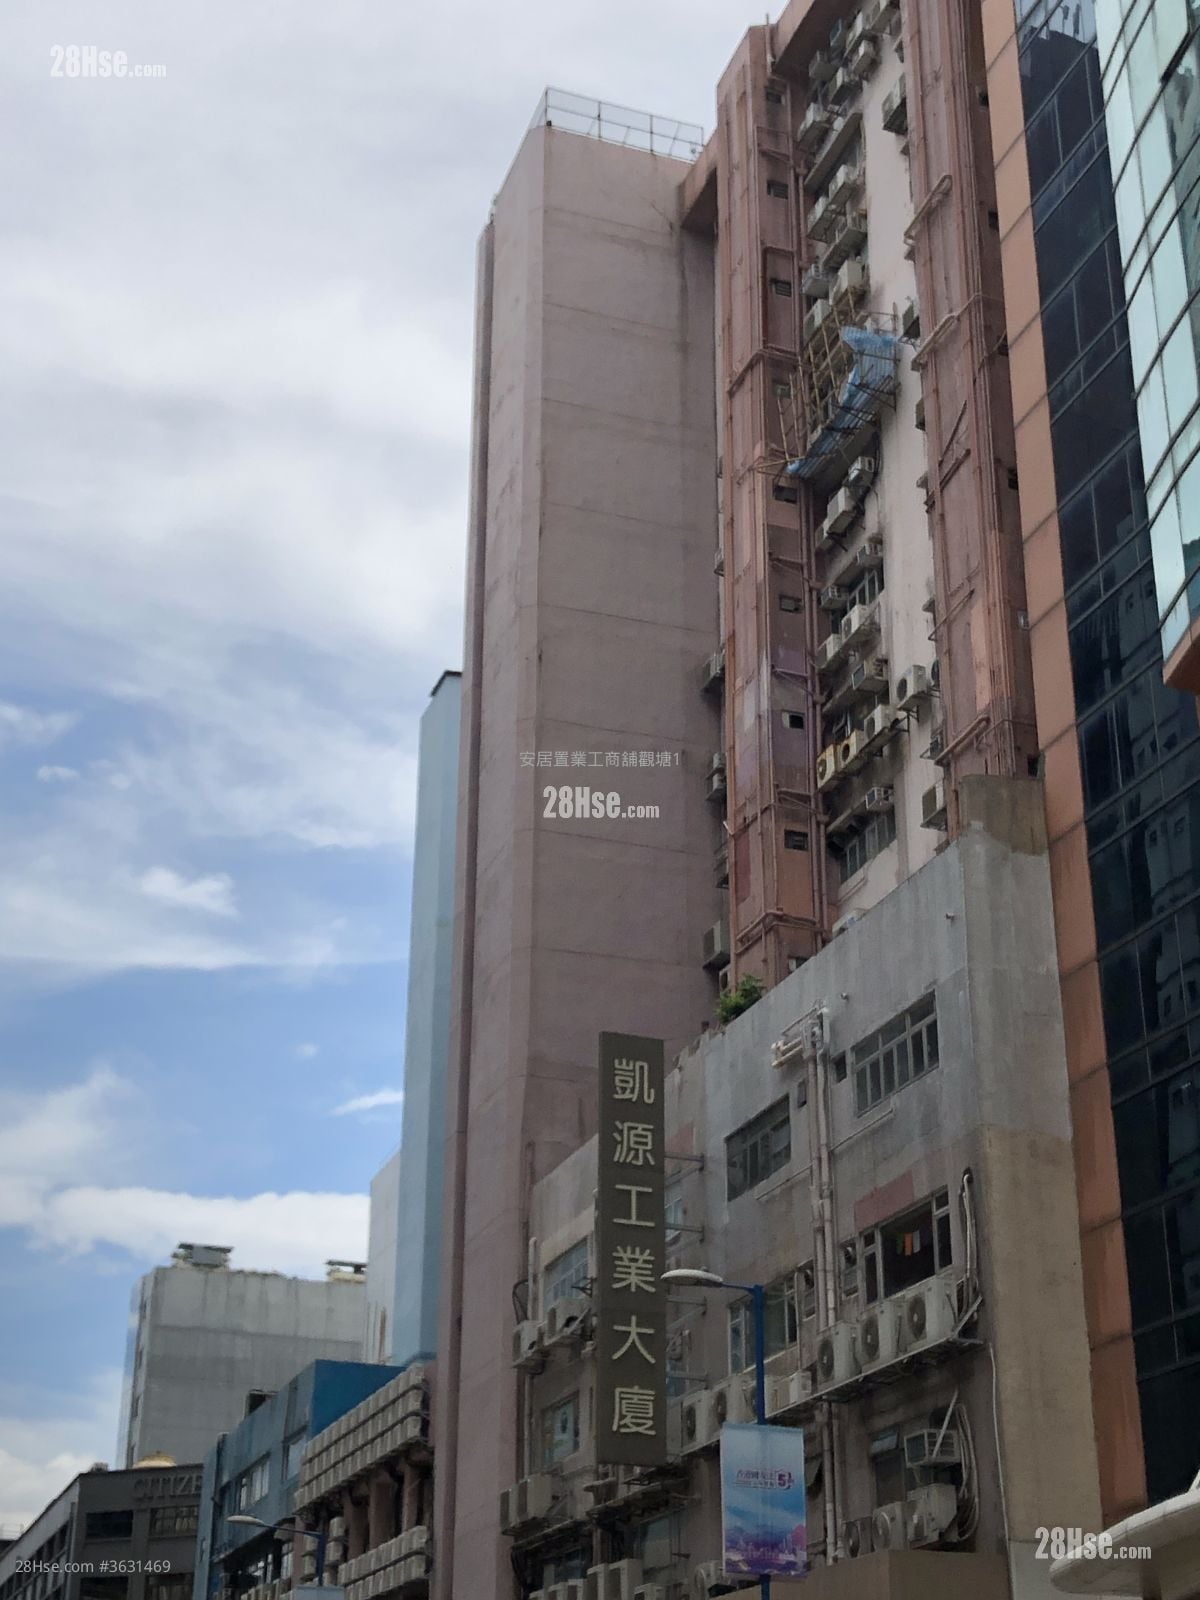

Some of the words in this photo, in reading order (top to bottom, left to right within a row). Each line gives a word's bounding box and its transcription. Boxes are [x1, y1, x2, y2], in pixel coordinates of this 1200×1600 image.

[611, 1057, 657, 1436] 凱源工業大廈
